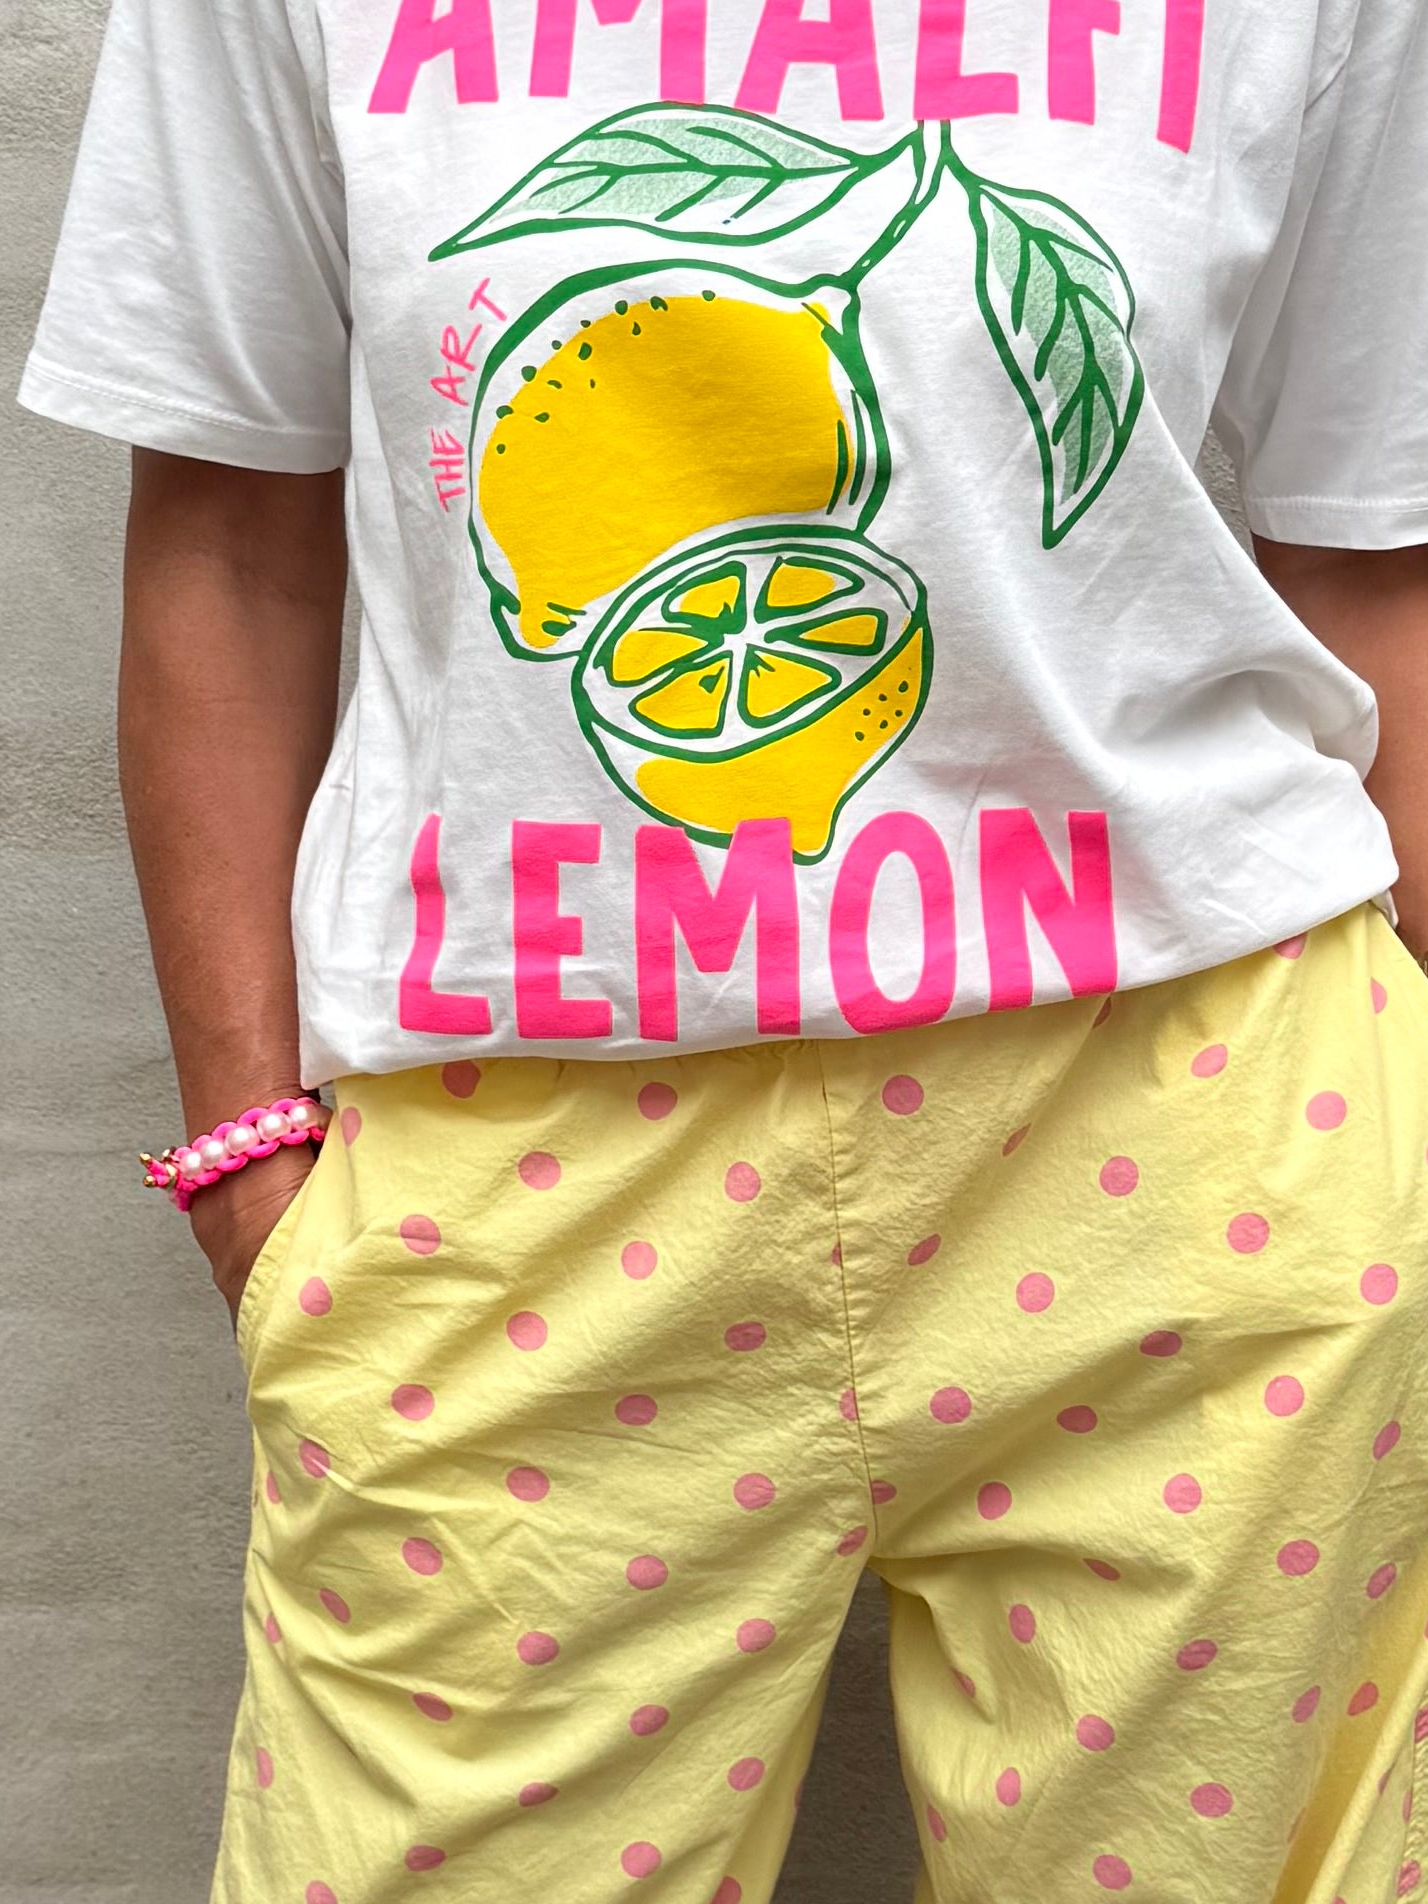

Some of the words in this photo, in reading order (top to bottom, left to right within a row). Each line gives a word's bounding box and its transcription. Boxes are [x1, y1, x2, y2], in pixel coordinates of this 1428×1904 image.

[429, 277, 507, 407] ART
[428, 425, 466, 513] THE
[396, 805, 1120, 1043] LEMON
